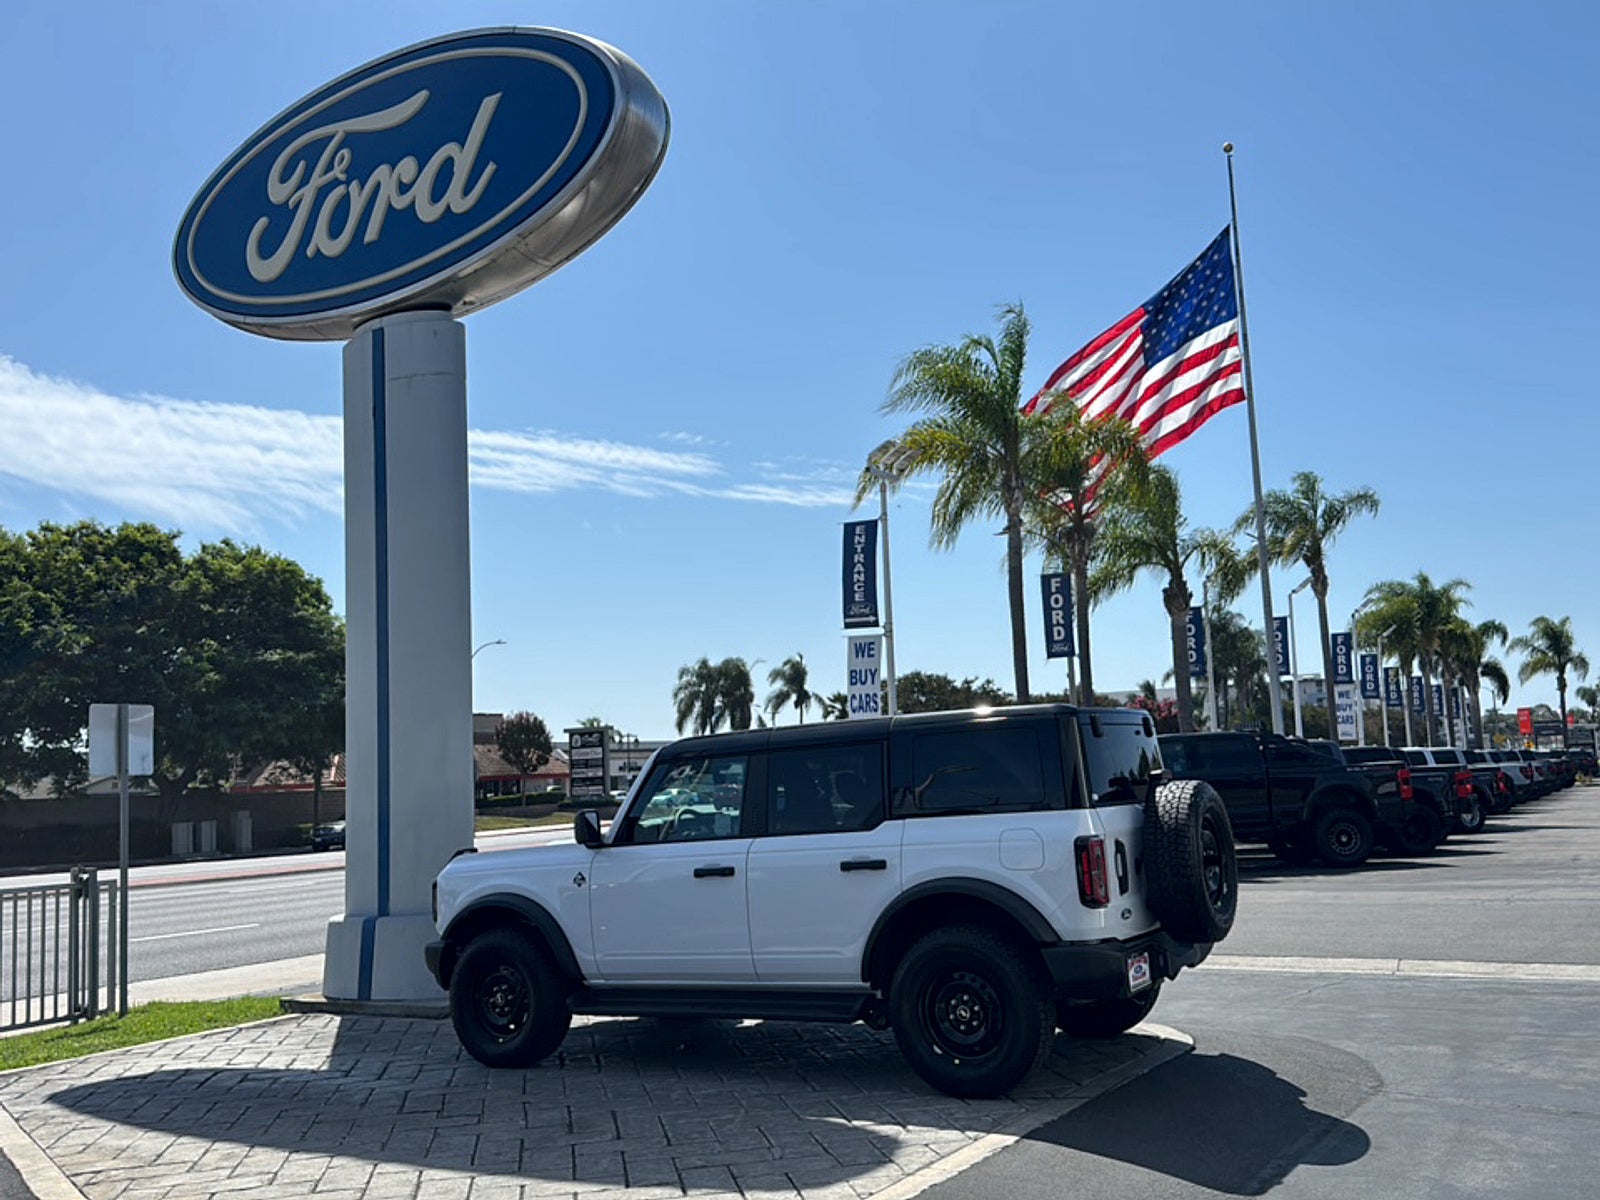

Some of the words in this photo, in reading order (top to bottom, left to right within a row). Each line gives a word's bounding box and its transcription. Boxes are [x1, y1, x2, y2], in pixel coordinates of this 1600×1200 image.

[246, 89, 502, 282] Ford
[853, 525, 866, 602] ENTRANCE
[1050, 578, 1065, 641] FORD
[854, 641, 876, 659] WE
[1336, 635, 1347, 675] FORD
[850, 668, 878, 687] BUY
[1365, 656, 1375, 690] FORD
[850, 693, 878, 714] CARS
